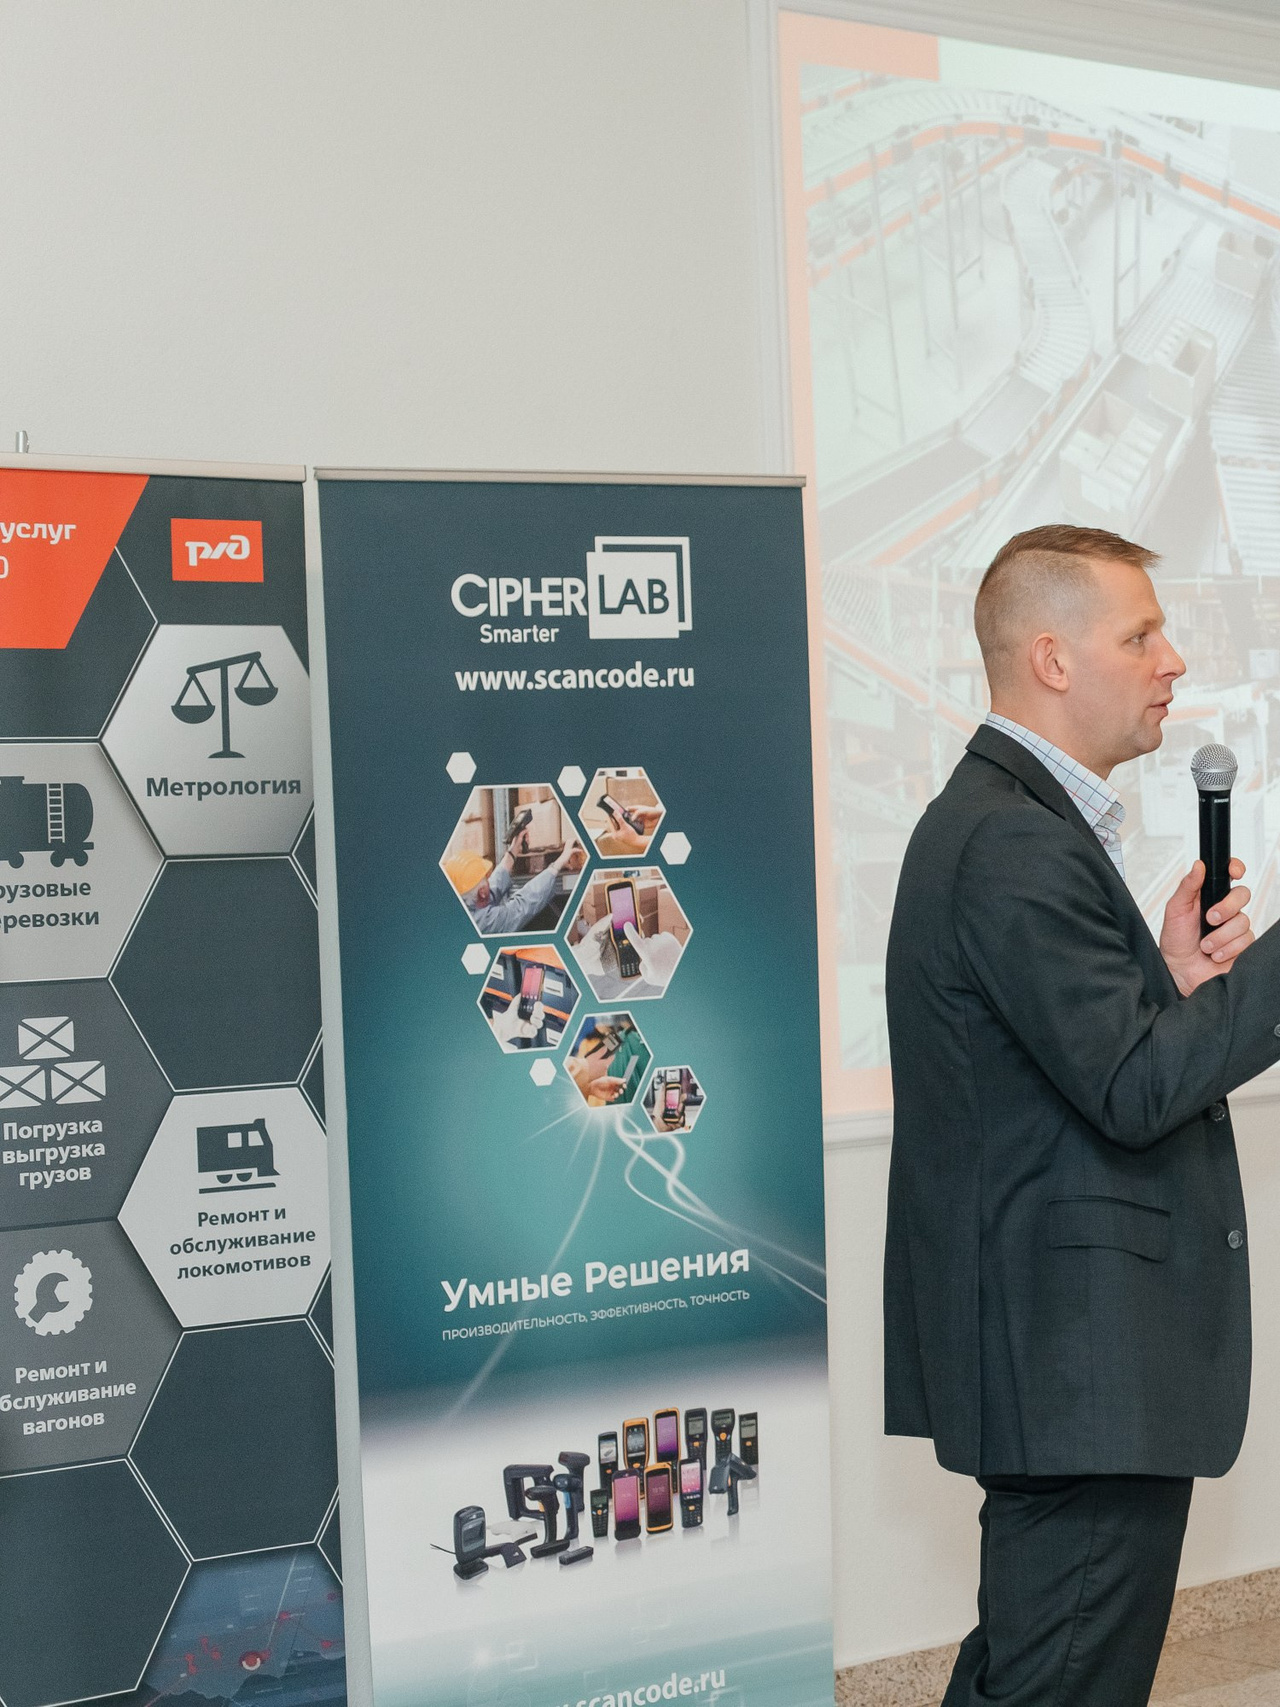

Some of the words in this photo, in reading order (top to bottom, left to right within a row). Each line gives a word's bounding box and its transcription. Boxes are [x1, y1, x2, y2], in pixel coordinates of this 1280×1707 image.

[480, 624, 559, 643] Smarter
[455, 661, 694, 691] www.scancode.ru
[146, 776, 302, 802] Метрология
[0, 912, 99, 933] ревозки
[3, 1119, 103, 1142] Погрузка
[3, 1143, 105, 1165] выгрузка
[20, 1167, 91, 1190] грузов
[198, 1209, 269, 1227] Ремонт
[275, 1208, 285, 1220] и
[170, 1230, 315, 1255] обслуживание
[178, 1255, 311, 1279] локомотивов
[441, 1272, 573, 1312] Умные
[585, 1249, 749, 1293] Решения
[442, 1312, 588, 1341] ПРОИЗВОДИТЕЛЬНОСТЬ,
[590, 1298, 688, 1322] ЭФФЕКТИВНОСТЬ,
[689, 1290, 750, 1306] ТОЧНОСТЬ
[15, 1363, 90, 1384] Ремонт
[95, 1361, 107, 1373] и
[23, 1413, 105, 1435] вагонов
